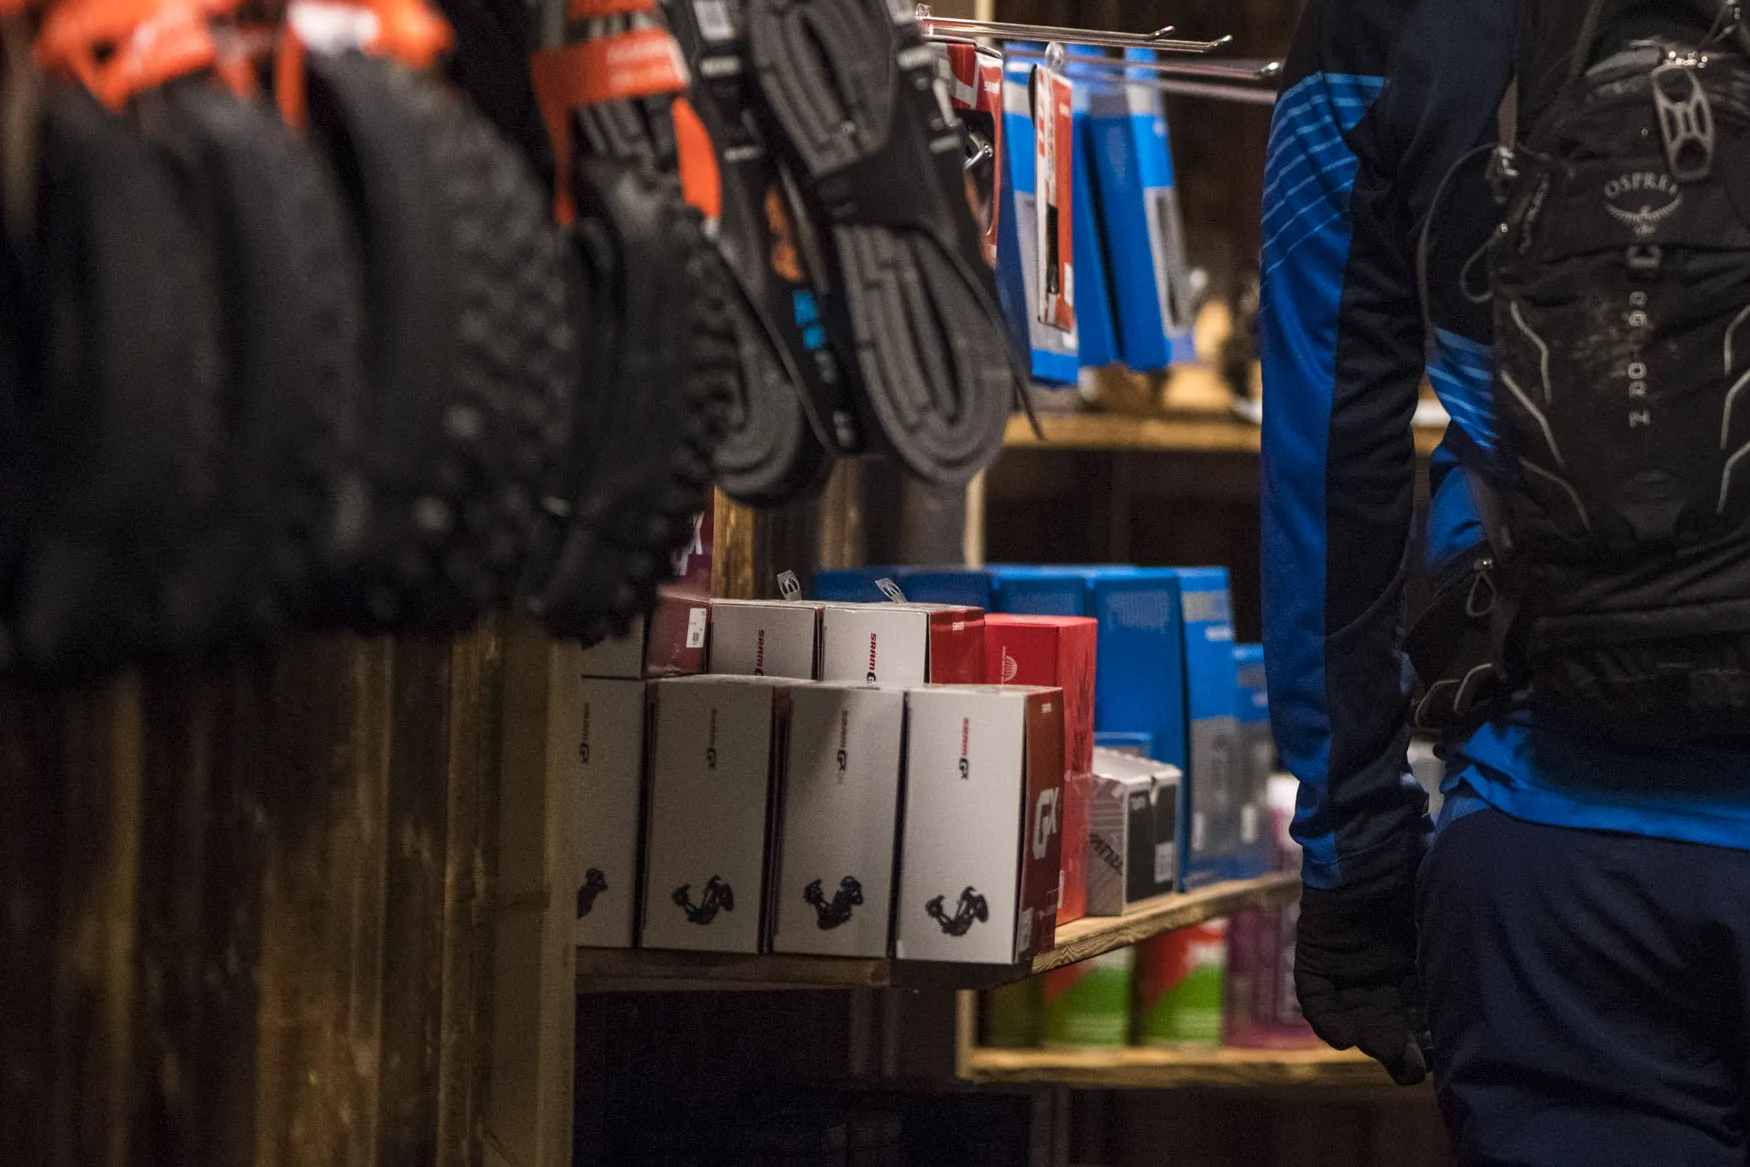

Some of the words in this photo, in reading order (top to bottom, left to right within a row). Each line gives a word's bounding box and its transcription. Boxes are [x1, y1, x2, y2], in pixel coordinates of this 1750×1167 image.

[868, 633, 877, 671] SRAM
[961, 717, 970, 757] SRAM
[836, 749, 848, 772] GX
[959, 758, 970, 781] GX
